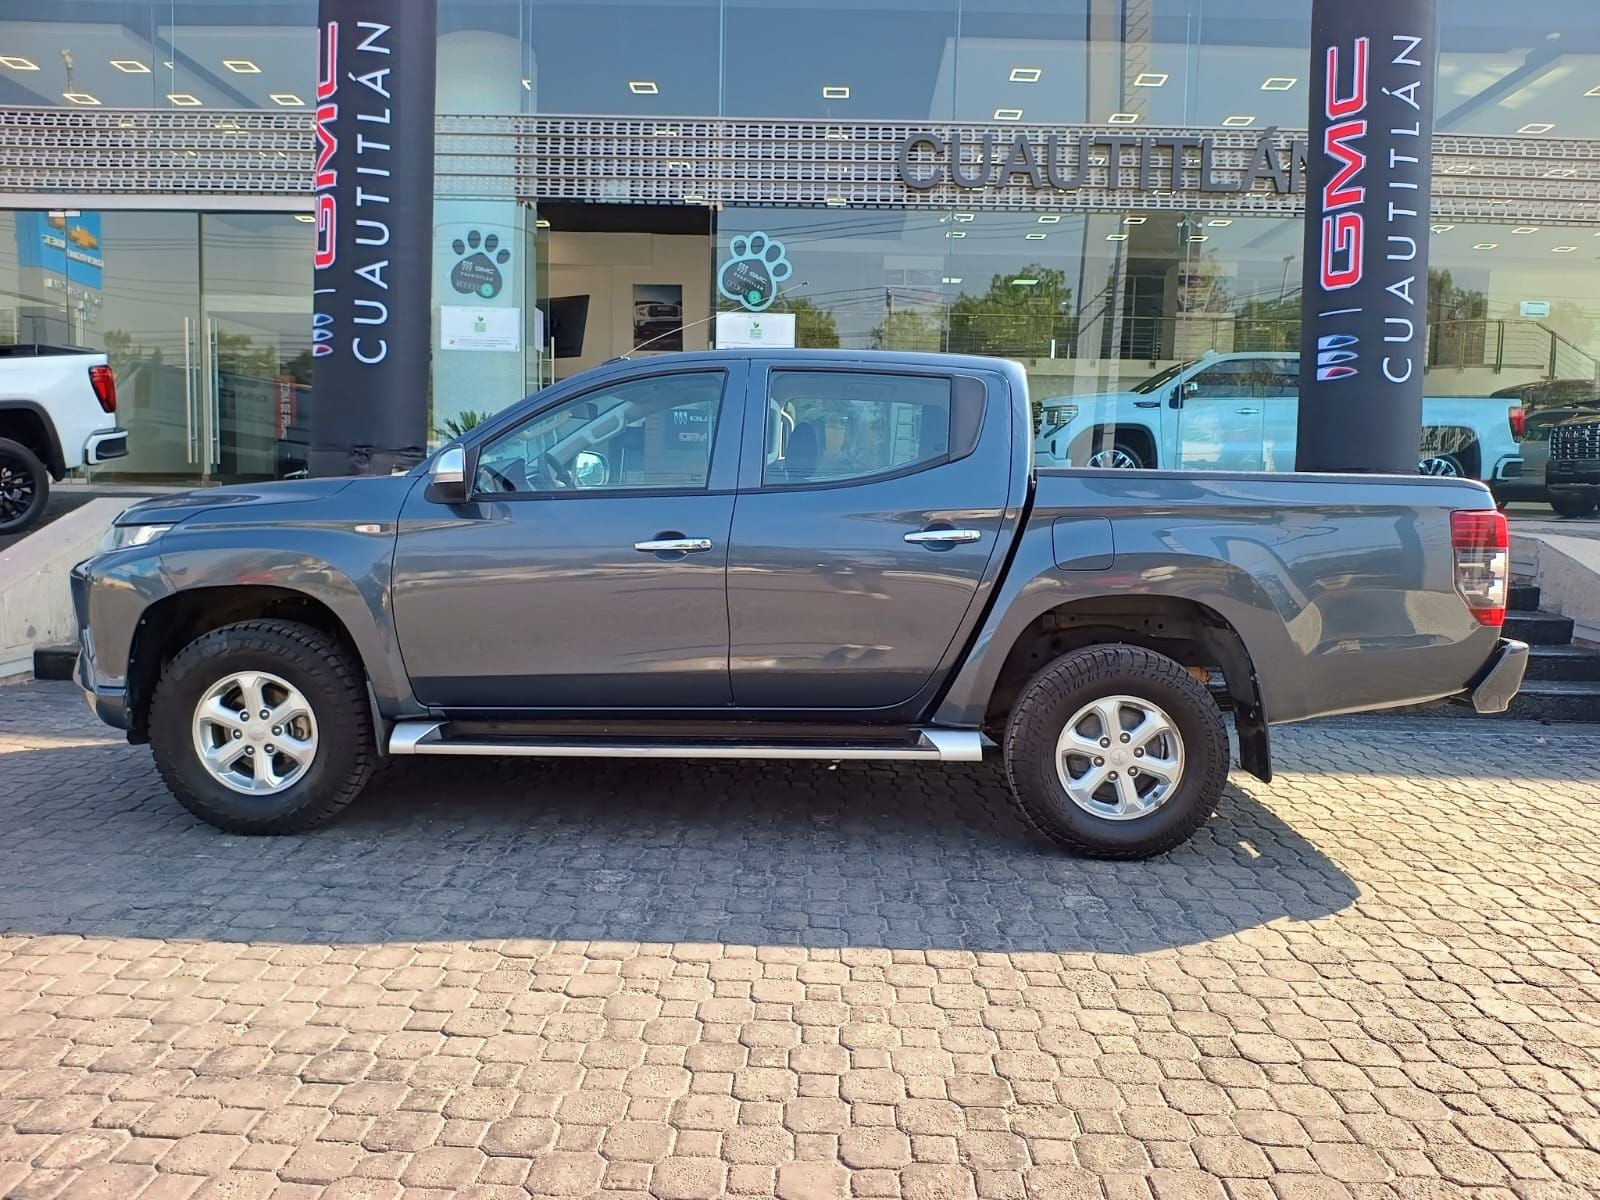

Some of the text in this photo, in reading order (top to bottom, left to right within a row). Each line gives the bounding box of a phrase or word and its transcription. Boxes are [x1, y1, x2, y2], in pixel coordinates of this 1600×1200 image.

[348, 21, 391, 364] CUAUTITLÁN
[1320, 36, 1369, 291] GMC
[1381, 35, 1423, 383] CUAUTITLÁN
